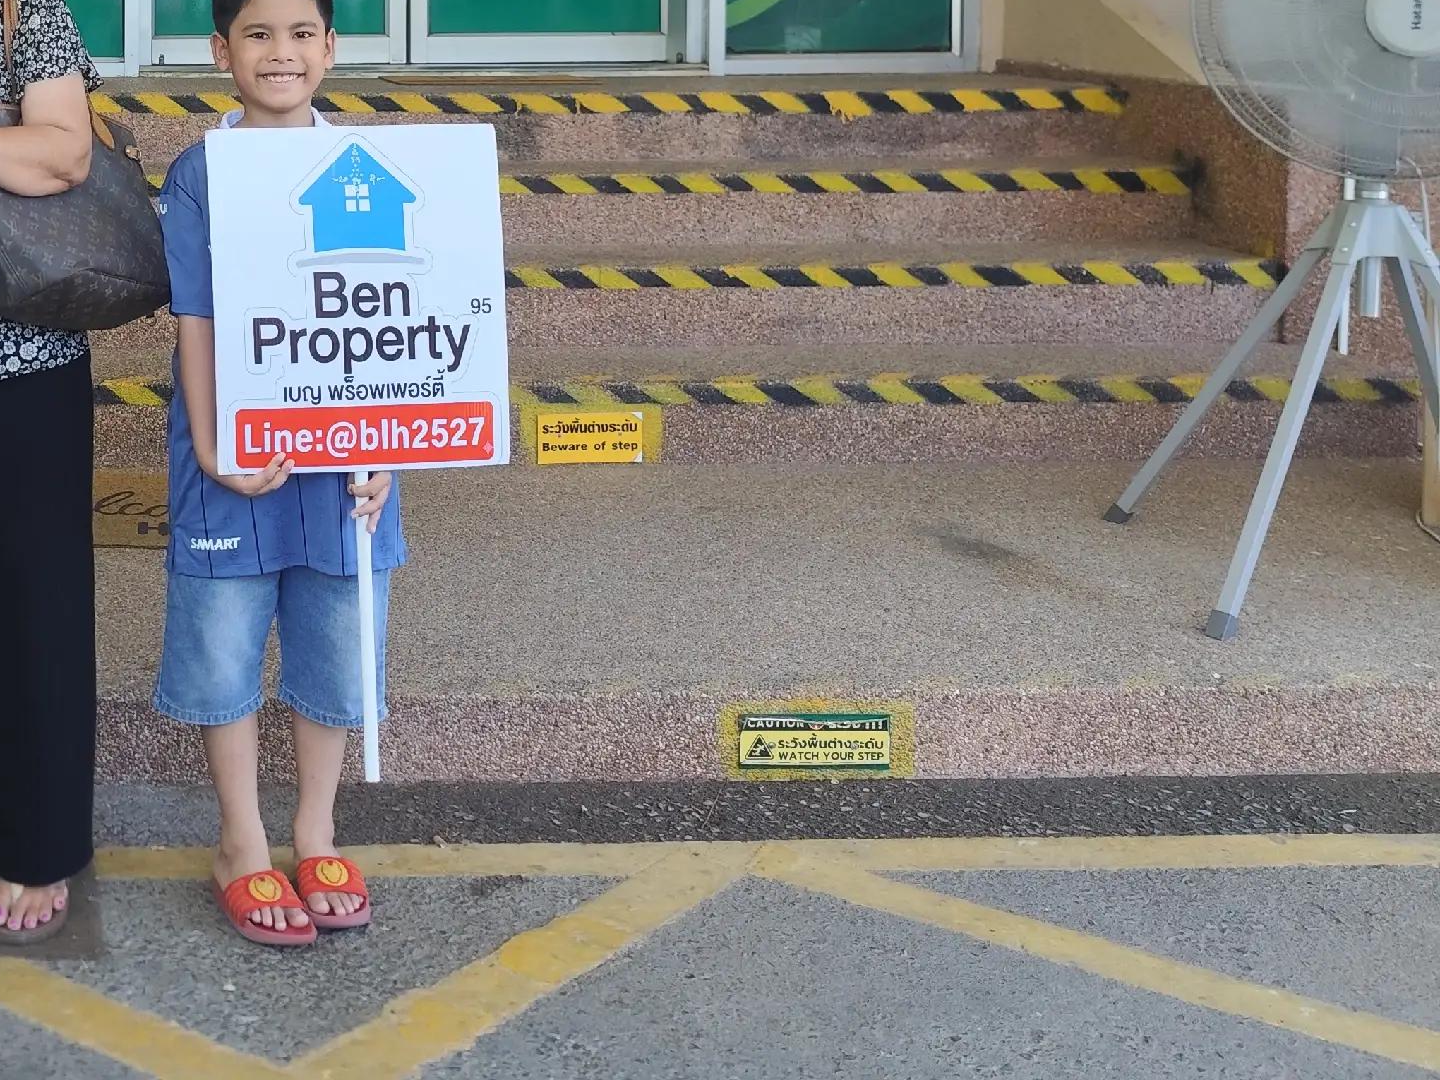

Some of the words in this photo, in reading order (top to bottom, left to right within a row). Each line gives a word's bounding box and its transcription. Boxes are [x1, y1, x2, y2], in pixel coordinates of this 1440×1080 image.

[313, 271, 412, 318] Ben
[471, 297, 492, 314] 95
[252, 315, 471, 374] Property
[283, 383, 322, 405] เบญ
[542, 417, 638, 435] ระวังพื้นต่างระดับ
[243, 416, 486, 458] Line:@blh2527
[542, 442, 588, 451] Beware
[593, 441, 606, 451] of
[611, 441, 638, 452] step
[778, 733, 884, 749] ระวังพื้นต่างระดับ
[778, 751, 819, 761] WATCH
[824, 751, 854, 761] YOUR
[857, 751, 885, 761] STEP
